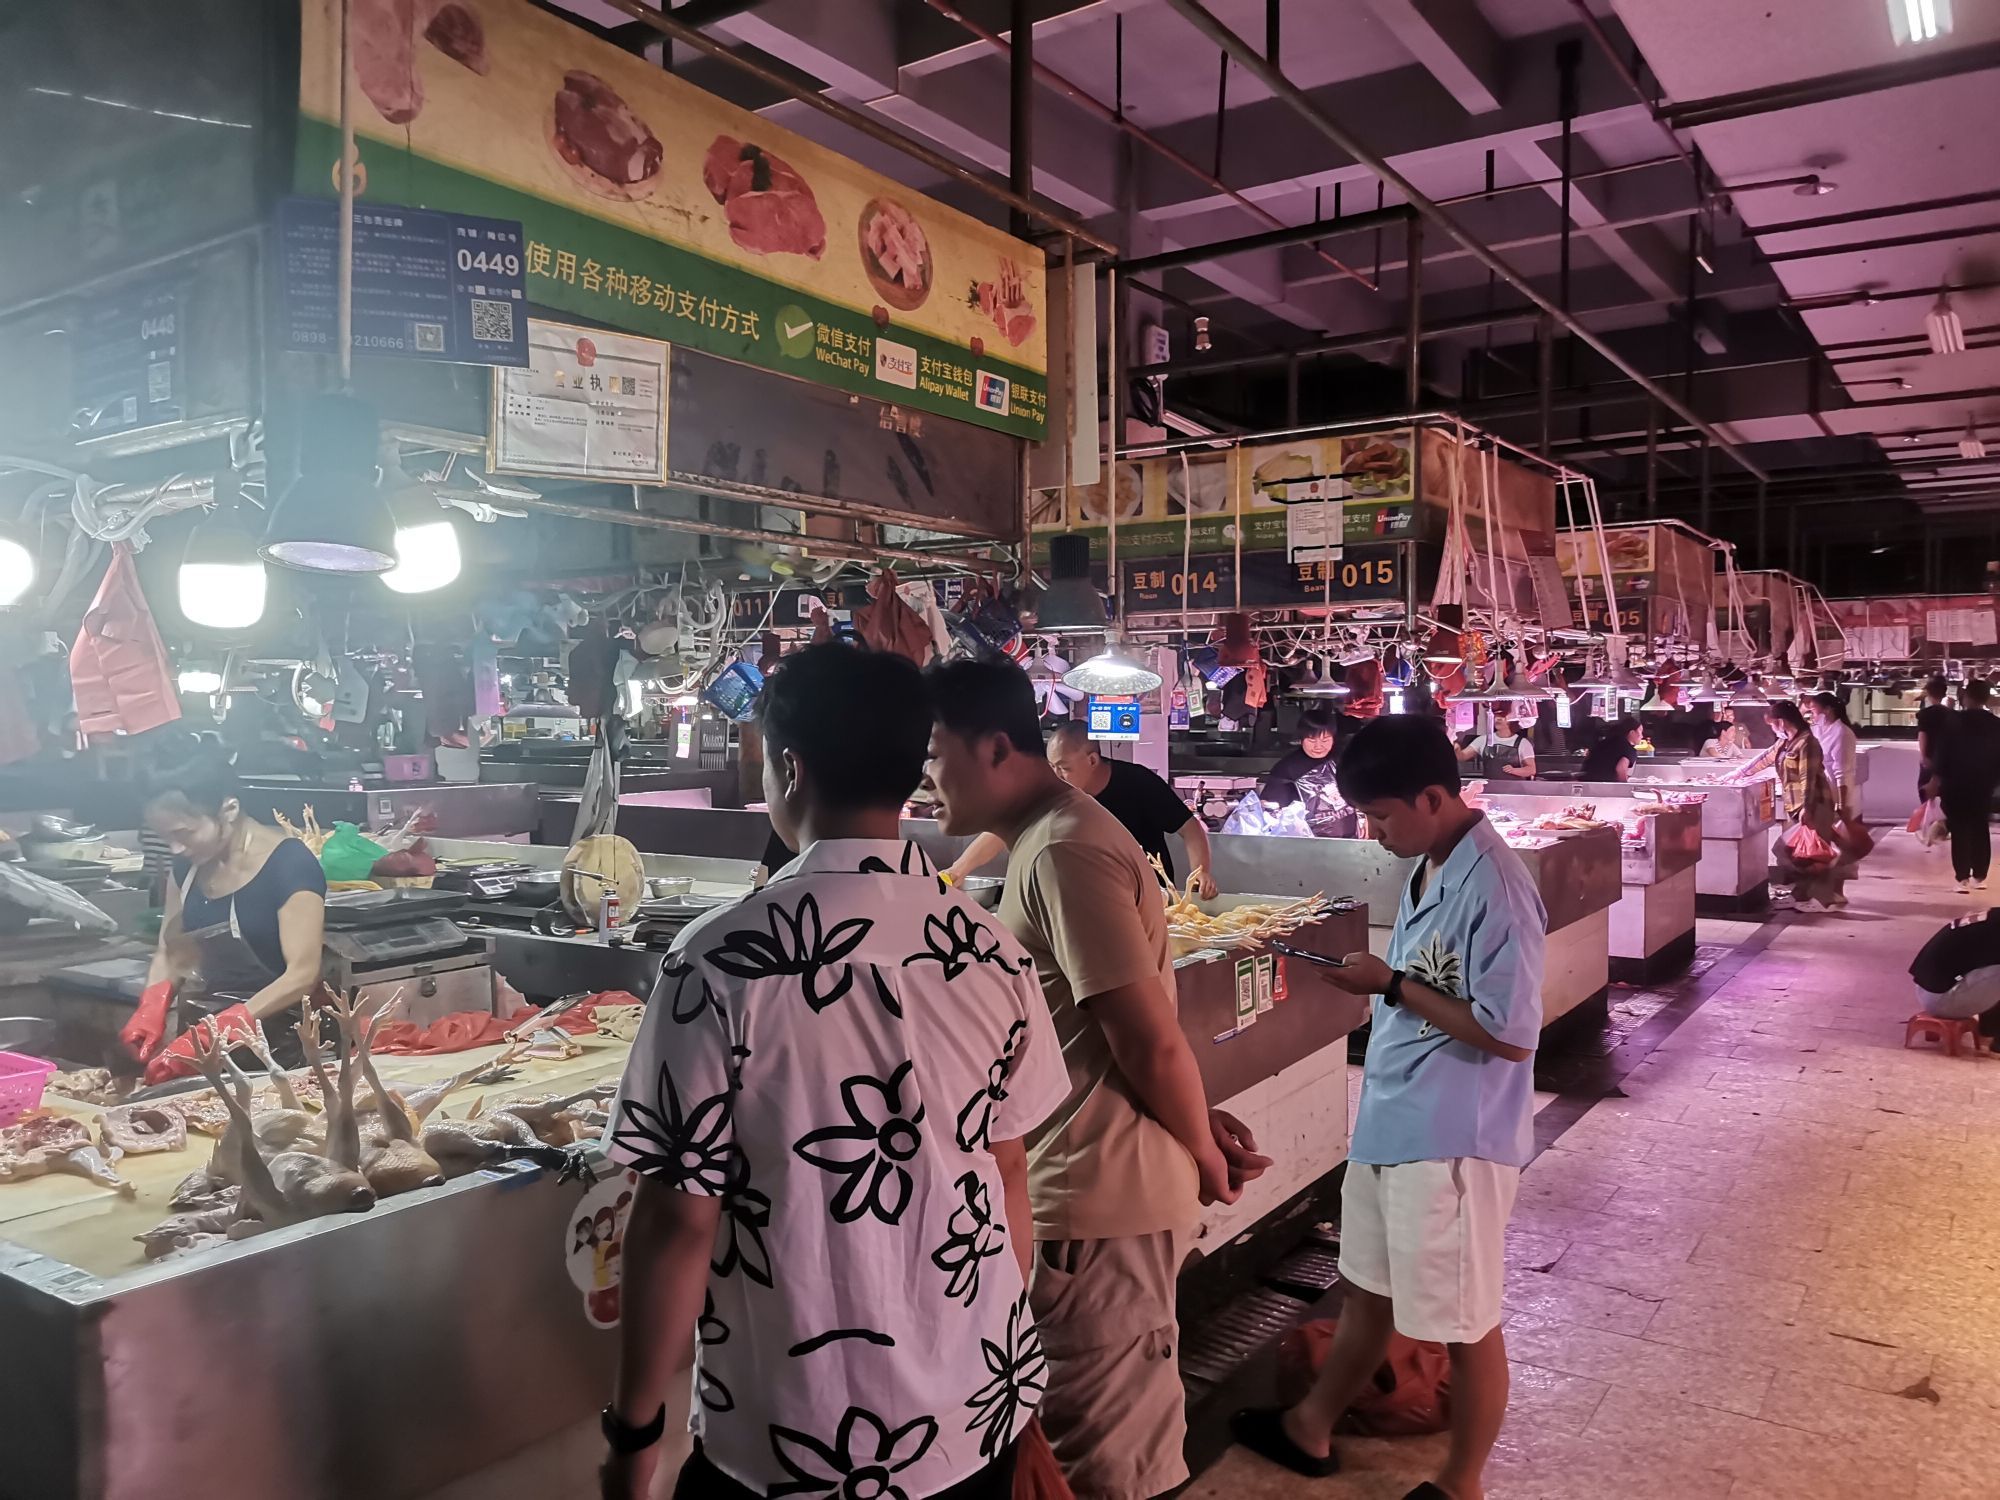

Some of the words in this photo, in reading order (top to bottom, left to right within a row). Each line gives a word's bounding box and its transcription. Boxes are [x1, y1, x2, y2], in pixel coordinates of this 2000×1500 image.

[457, 248, 520, 277] 0449
[525, 240, 760, 341] 使用各种移动支付方式
[816, 323, 872, 358] 微信支付
[815, 347, 852, 370] WeChat
[853, 359, 870, 377] Pay
[920, 356, 974, 387] 支付宝钱包
[919, 377, 945, 397] Alipay
[945, 384, 970, 402] Wallet
[1011, 382, 1047, 409] 银联支付
[1010, 402, 1031, 418] Union
[1031, 408, 1045, 425] Pay
[1133, 571, 1165, 590] 豆制
[1171, 571, 1218, 595] 014
[1297, 561, 1335, 582] 豆制
[1342, 560, 1393, 588] 015
[1603, 610, 1641, 628] 005
